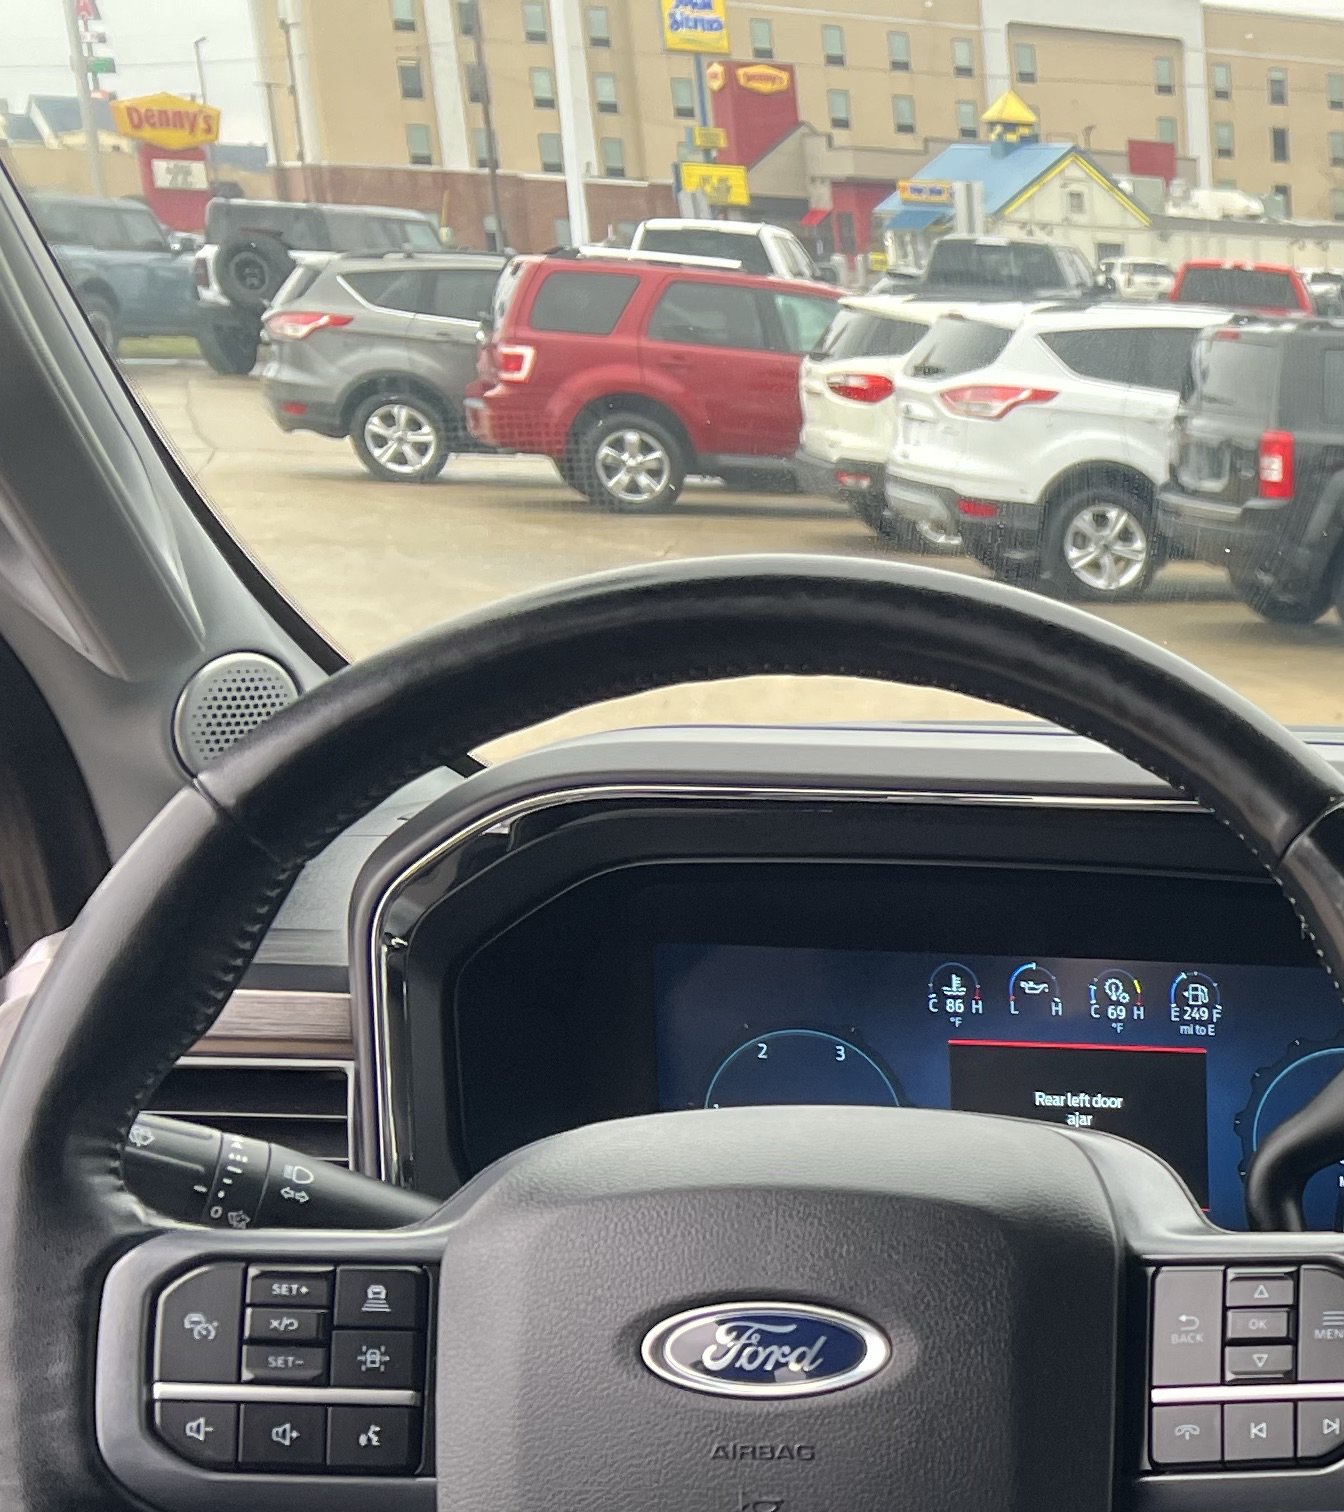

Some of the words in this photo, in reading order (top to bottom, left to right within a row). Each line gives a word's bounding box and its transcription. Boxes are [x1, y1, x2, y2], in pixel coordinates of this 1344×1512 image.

[126, 105, 213, 137] Denny's
[928, 999, 938, 1013] C
[945, 999, 965, 1013] 86
[971, 1001, 983, 1014] H
[1010, 1001, 1020, 1015] L
[1051, 1001, 1062, 1016] H
[1090, 1004, 1101, 1018] C
[1107, 1005, 1126, 1019] 69
[1133, 1006, 1144, 1020] H
[1170, 1007, 1180, 1022] E
[1183, 1007, 1209, 1021] 249
[1212, 1009, 1222, 1023] F
[1180, 1024, 1193, 1036] mi
[1195, 1025, 1206, 1036] to
[1208, 1026, 1216, 1036] E
[757, 1043, 768, 1059] 2
[835, 1046, 846, 1061] 3
[1035, 1092, 1066, 1107] Rear
[1067, 1092, 1090, 1108] left
[1092, 1093, 1124, 1109] door
[1066, 1112, 1093, 1128] ajar
[1248, 1318, 1268, 1330] OK
[1170, 1331, 1205, 1344] BACK
[702, 1320, 827, 1372] Ford
[711, 1444, 816, 1461] AIRBAG
